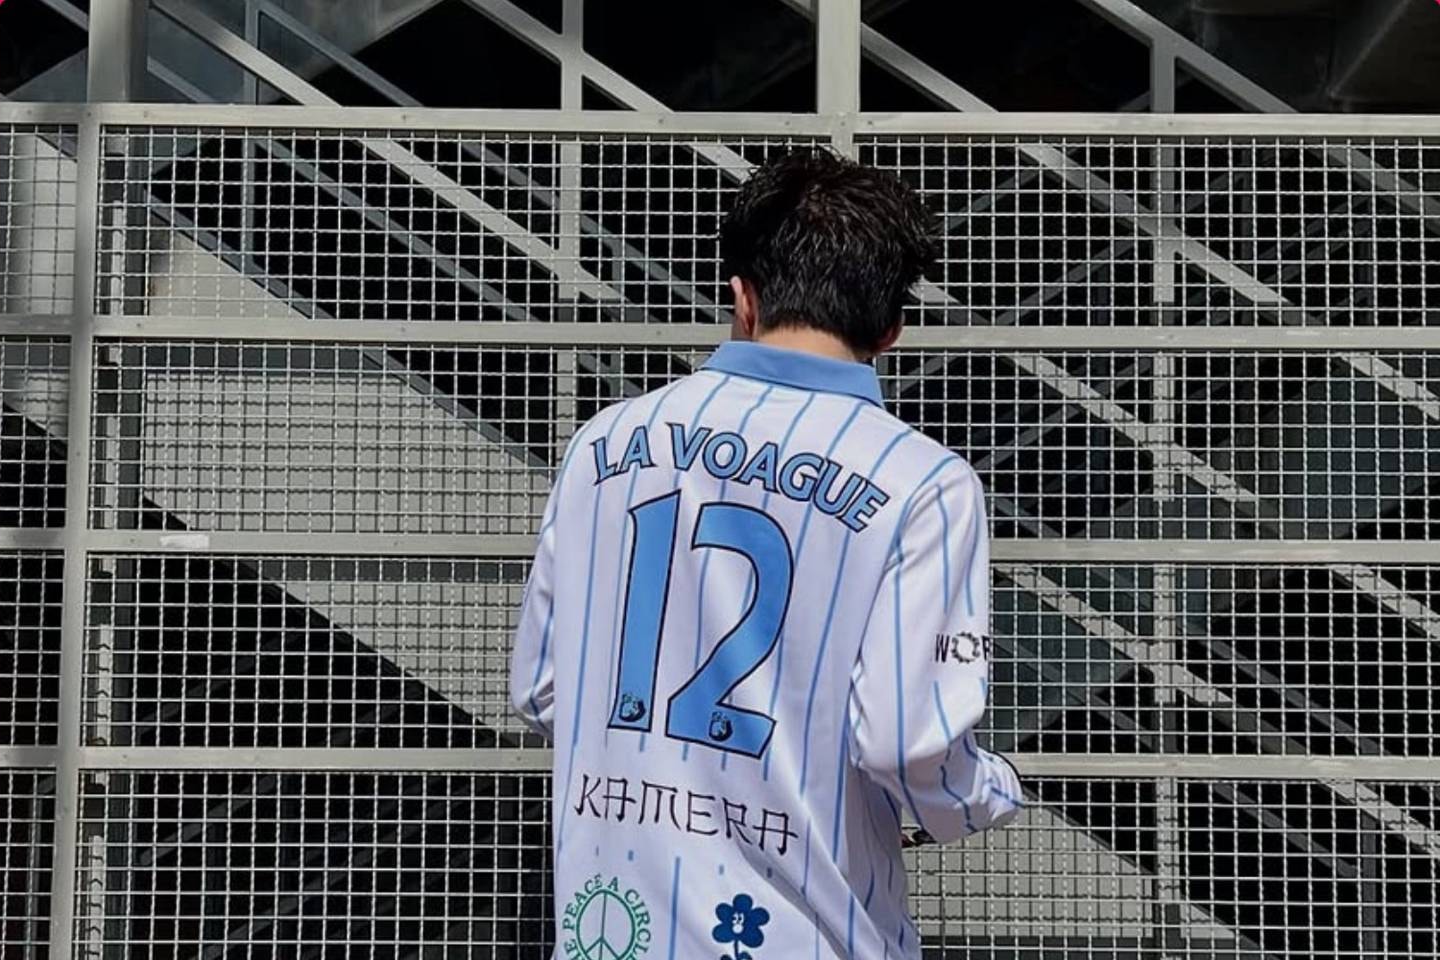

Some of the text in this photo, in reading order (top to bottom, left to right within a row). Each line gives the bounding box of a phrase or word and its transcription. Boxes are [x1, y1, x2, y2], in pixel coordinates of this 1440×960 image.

[590, 422, 890, 534] LA VOAGUE
[607, 489, 796, 760] 12
[575, 774, 799, 856] KAMERA
[562, 874, 603, 931] PEACE
[607, 876, 619, 892] A
